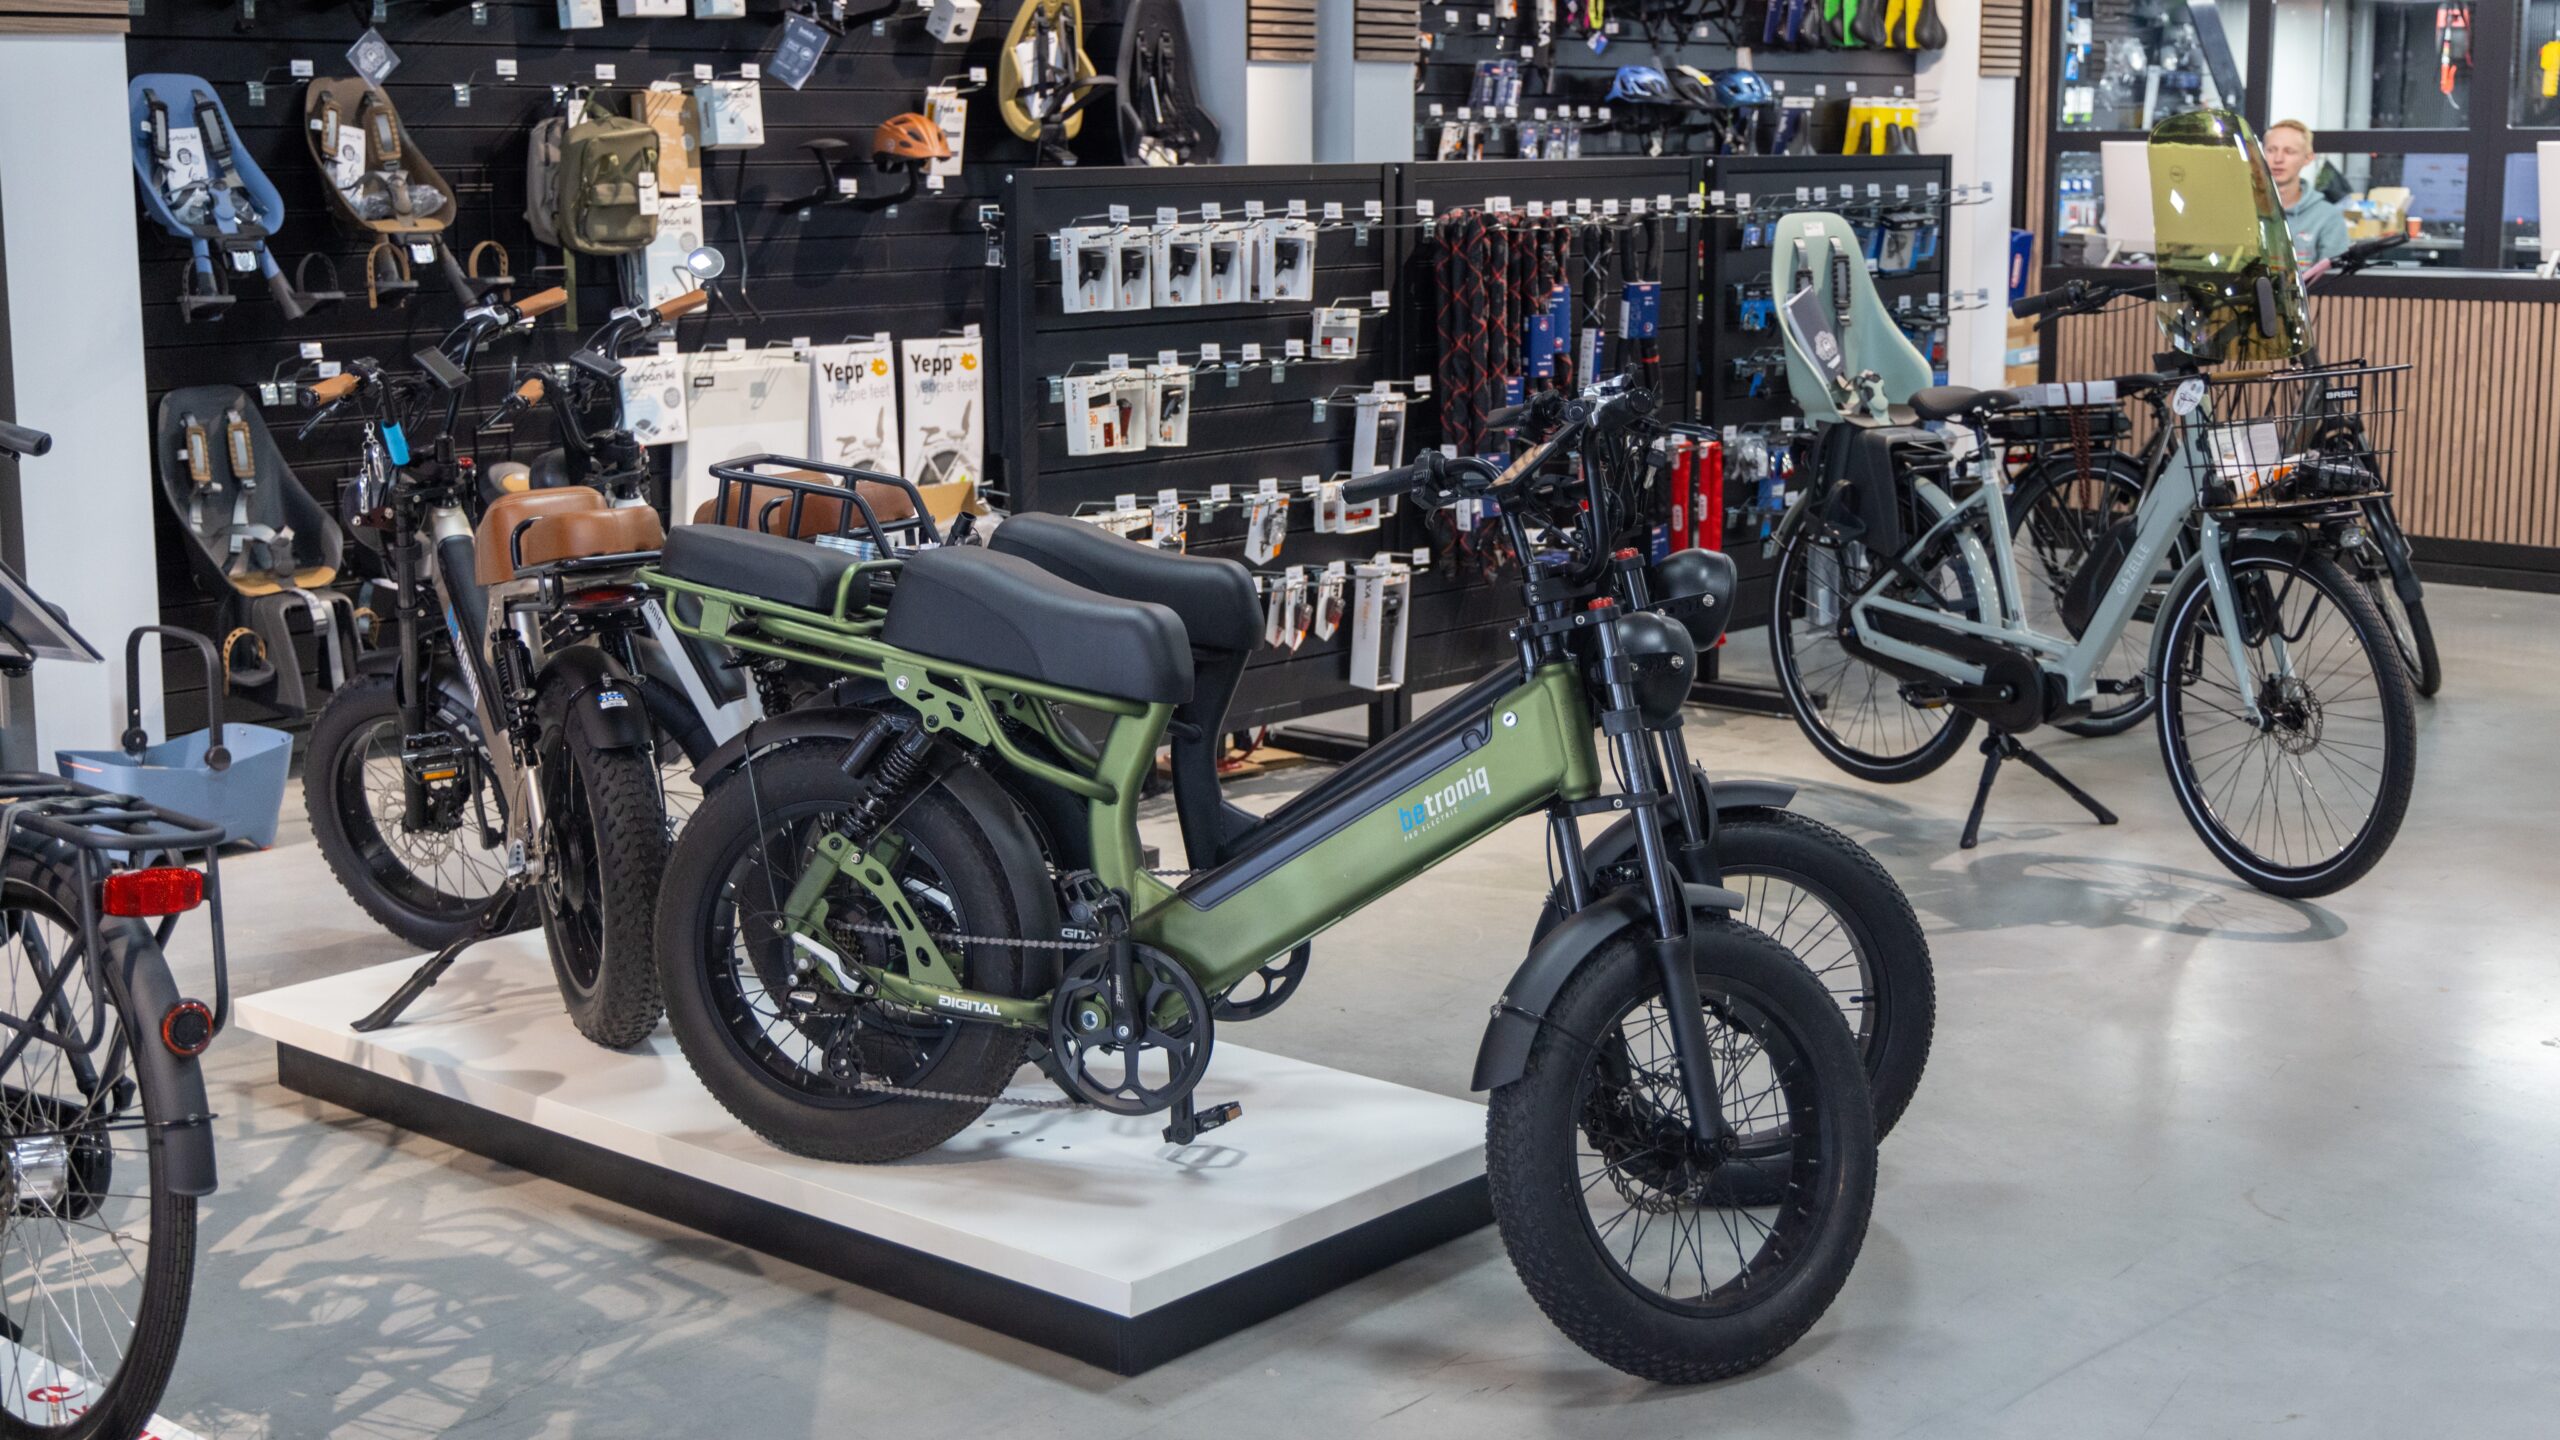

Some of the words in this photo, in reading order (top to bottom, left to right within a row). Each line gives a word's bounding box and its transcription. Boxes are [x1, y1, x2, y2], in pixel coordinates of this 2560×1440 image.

[822, 362, 864, 385] Yepp
[910, 354, 953, 377] Yepp
[2116, 543, 2150, 595] GAZELLE
[648, 600, 663, 631] oniq
[1397, 766, 1491, 833] betroniq
[938, 994, 1001, 1016] DIGITAL
